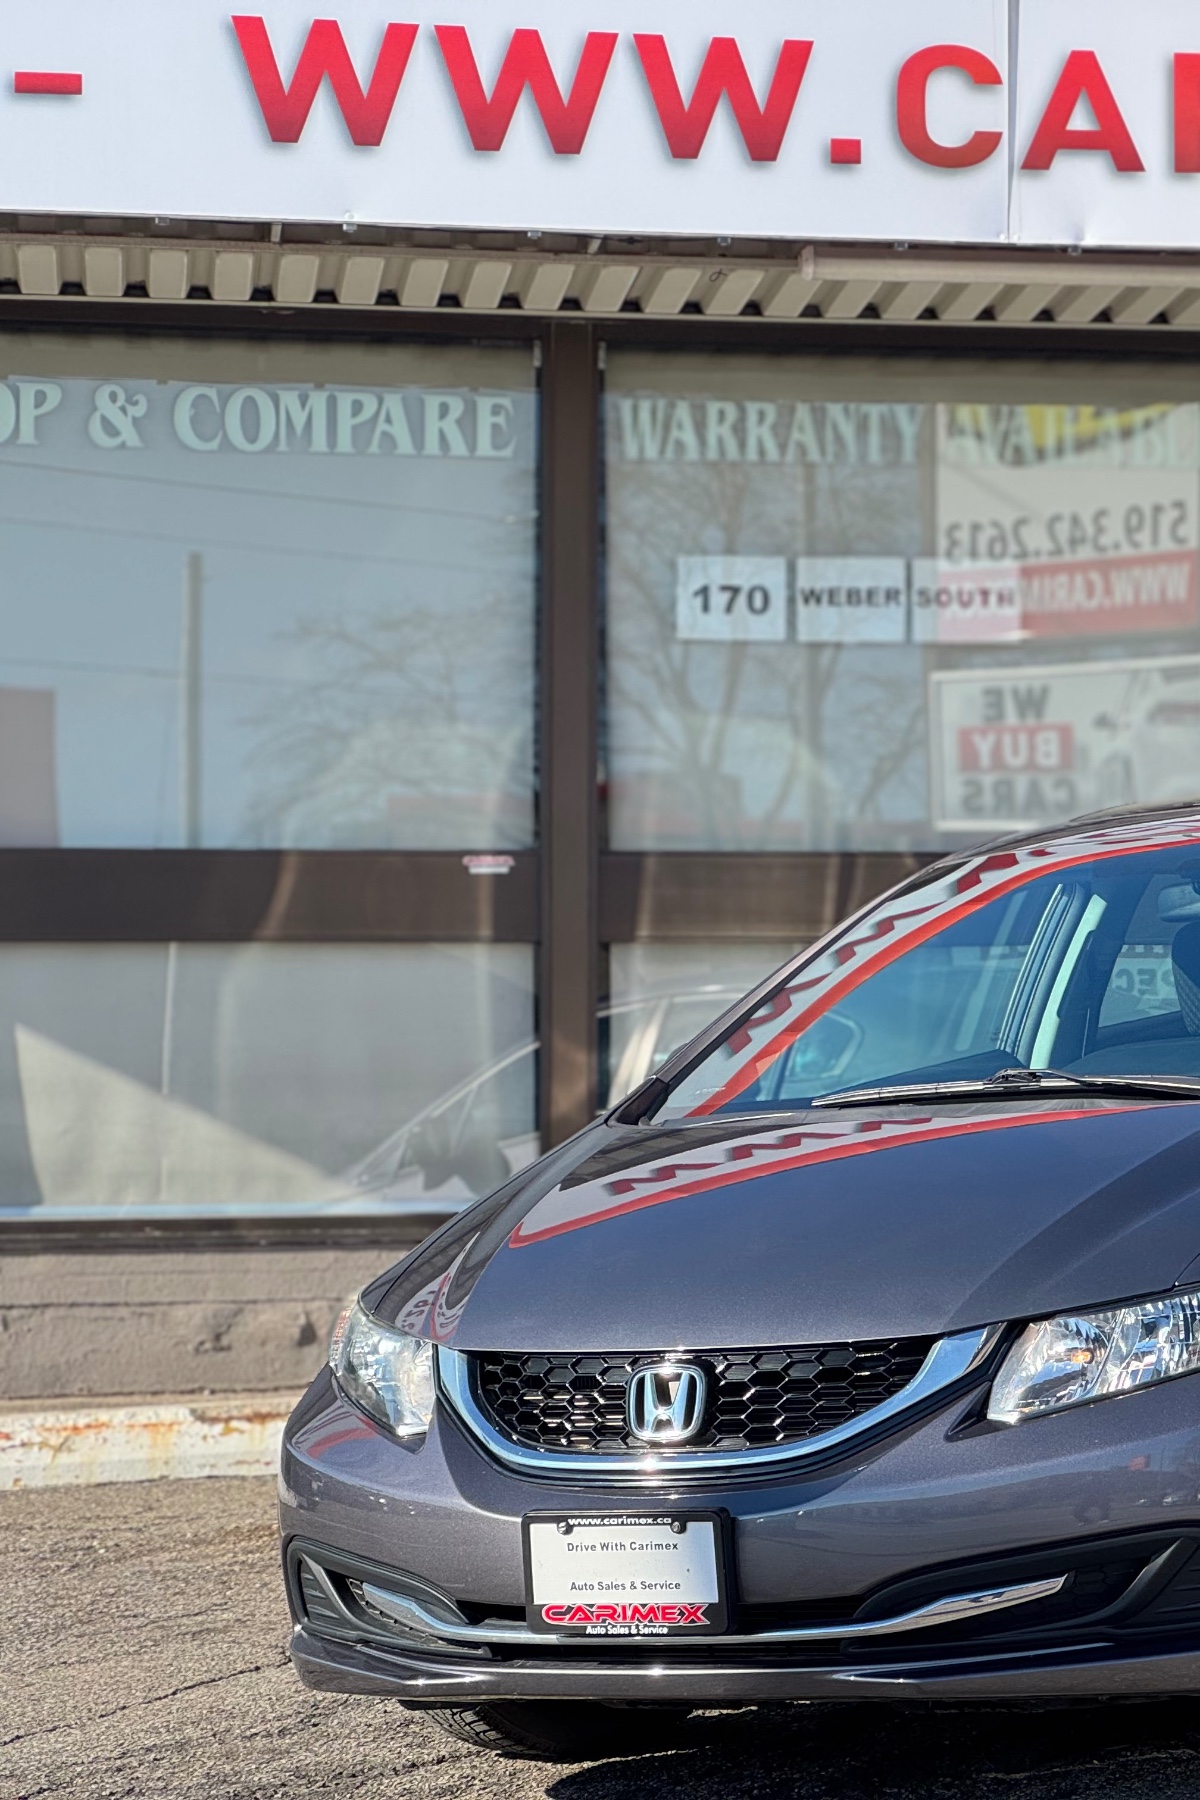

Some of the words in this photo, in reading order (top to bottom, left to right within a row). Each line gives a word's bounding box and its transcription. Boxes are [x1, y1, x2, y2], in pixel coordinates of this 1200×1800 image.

[0, 382, 62, 446] P
[87, 383, 148, 449] &
[172, 385, 517, 458] COMPARE
[618, 398, 925, 465] WARRANTY
[693, 583, 770, 615] 170
[801, 585, 900, 608] WEBER
[915, 586, 1014, 609] SOUTH
[567, 1515, 672, 1526] www.carimex.ca
[566, 1542, 597, 1552] Drive
[599, 1541, 626, 1552] With
[629, 1540, 679, 1551] Carimex
[569, 1581, 595, 1592] Auto
[597, 1581, 627, 1591] Sales
[629, 1580, 637, 1590] &
[640, 1580, 681, 1591] Service
[541, 1603, 710, 1626] CARIMEX
[585, 1625, 607, 1635] Auto
[607, 1625, 629, 1635] Sales
[630, 1624, 638, 1634] &
[639, 1624, 669, 1635] Service
